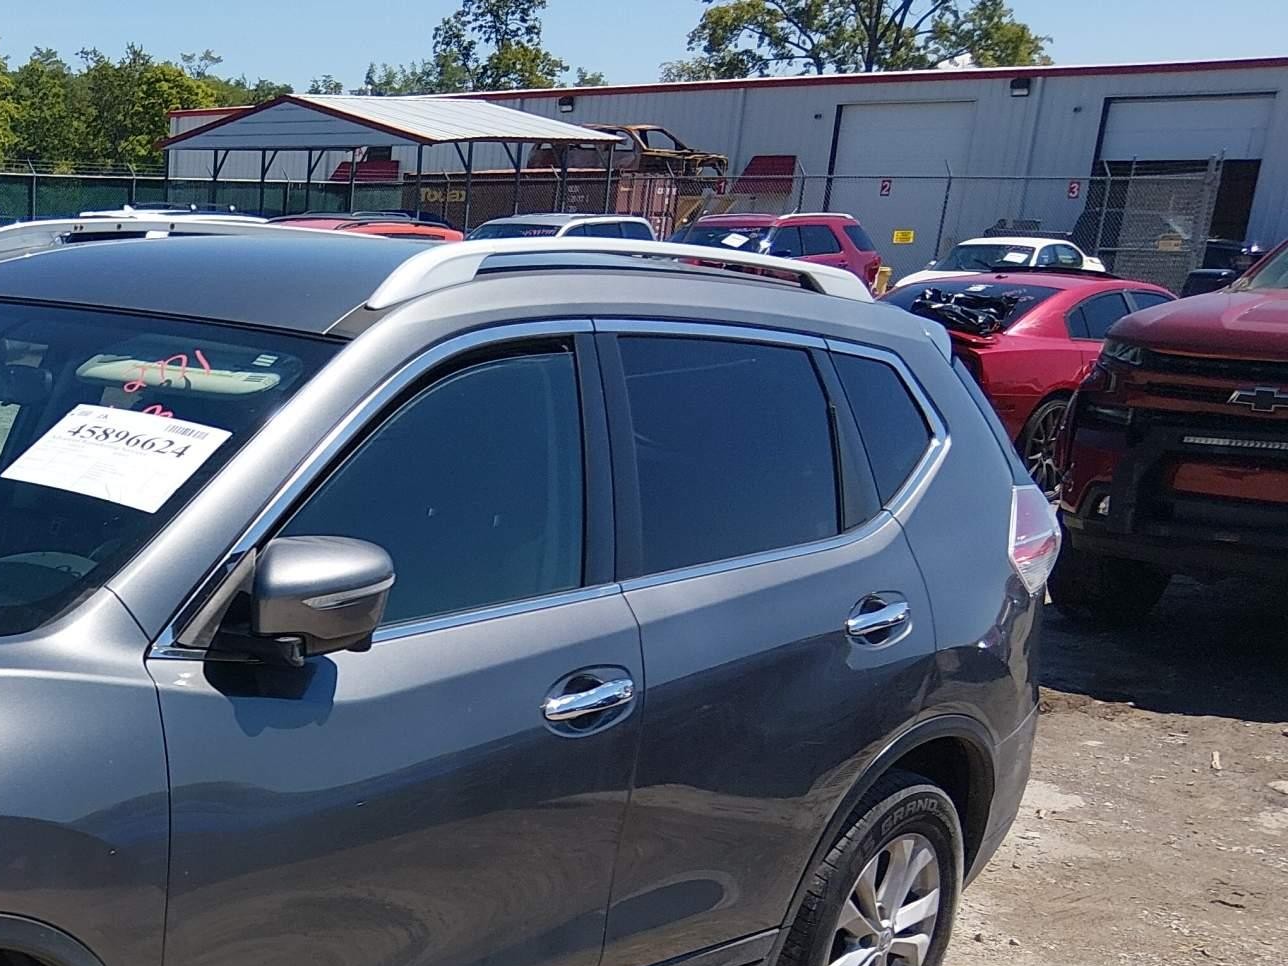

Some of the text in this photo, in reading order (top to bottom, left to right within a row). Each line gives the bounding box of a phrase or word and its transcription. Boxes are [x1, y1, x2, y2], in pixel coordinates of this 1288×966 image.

[881, 181, 890, 195] 2
[1068, 183, 1080, 198] 3
[67, 423, 192, 458] 45896624
